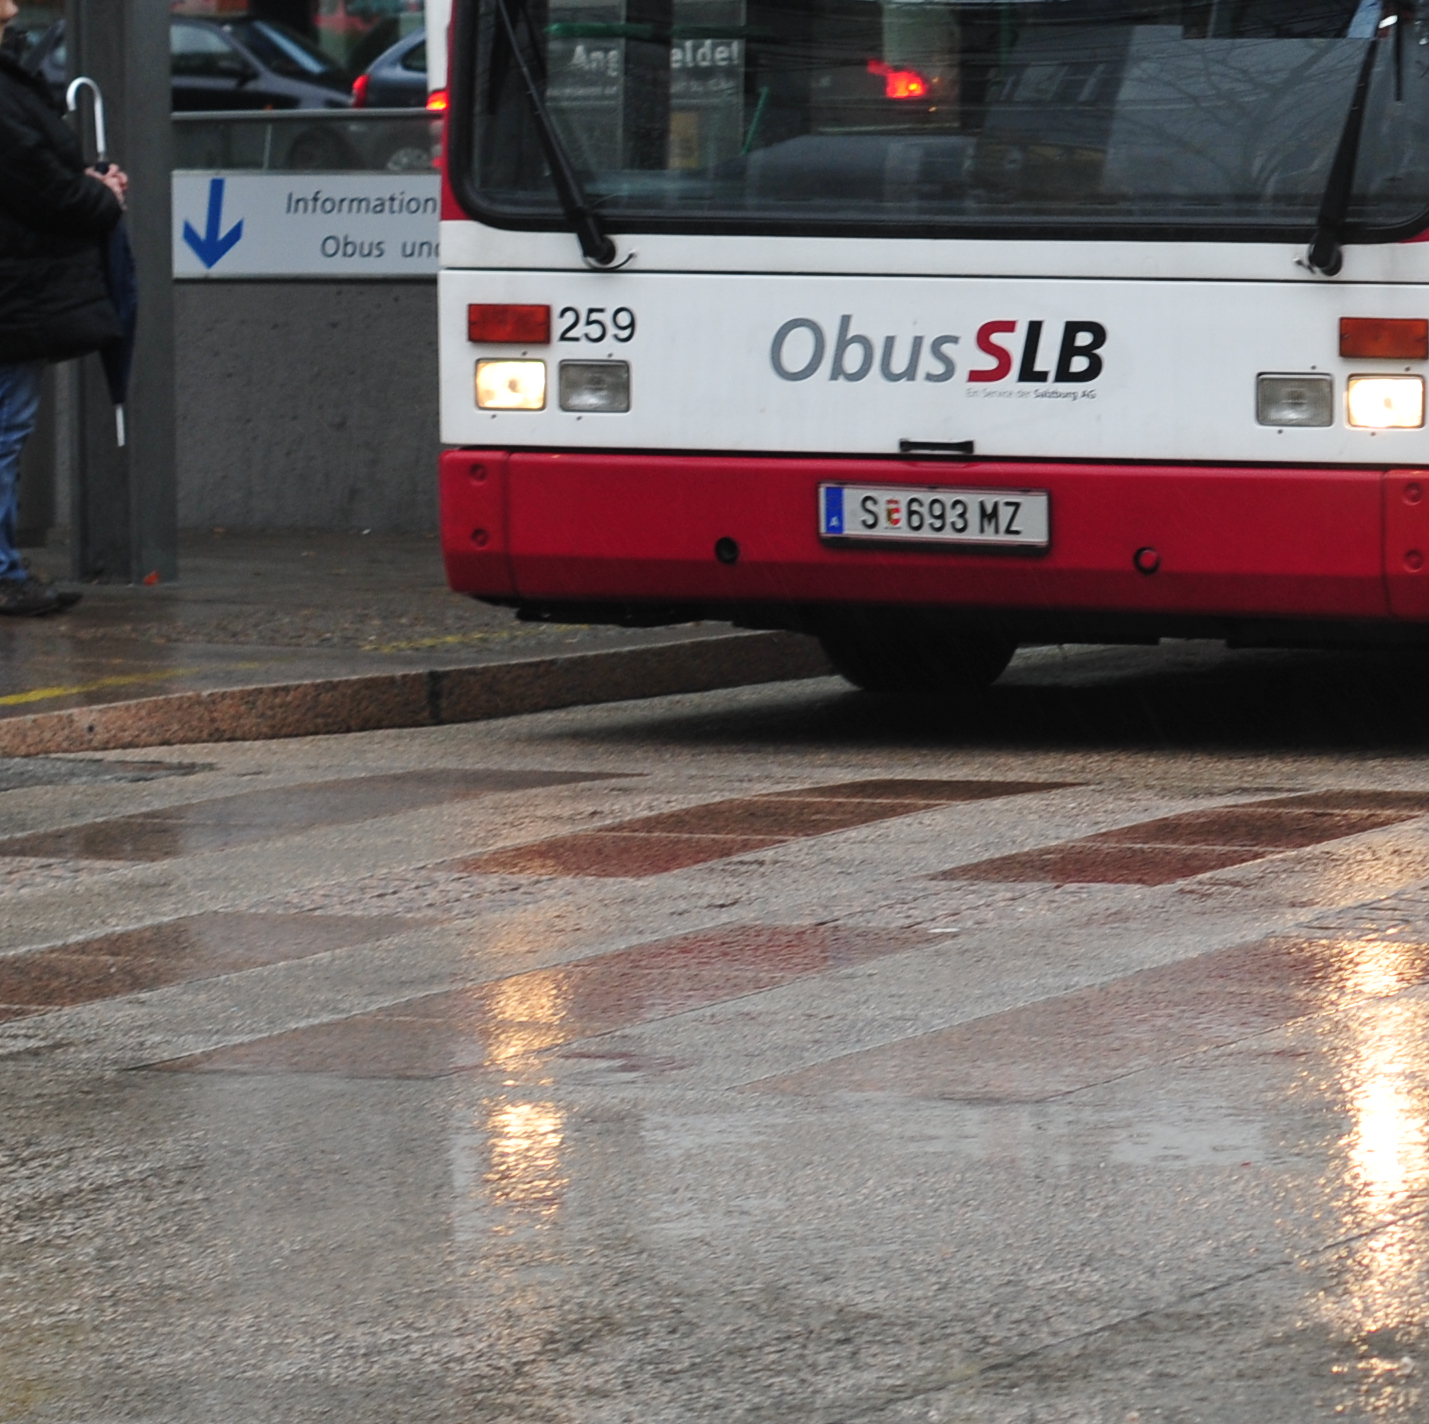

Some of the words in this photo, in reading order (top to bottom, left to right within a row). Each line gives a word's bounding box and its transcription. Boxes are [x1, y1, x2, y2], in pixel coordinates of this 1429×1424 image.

[285, 190, 438, 216] Information
[320, 233, 385, 259] Obus
[558, 306, 637, 343] 259
[860, 494, 880, 530] S
[906, 496, 970, 534] 693
[978, 498, 1024, 536] MZ
